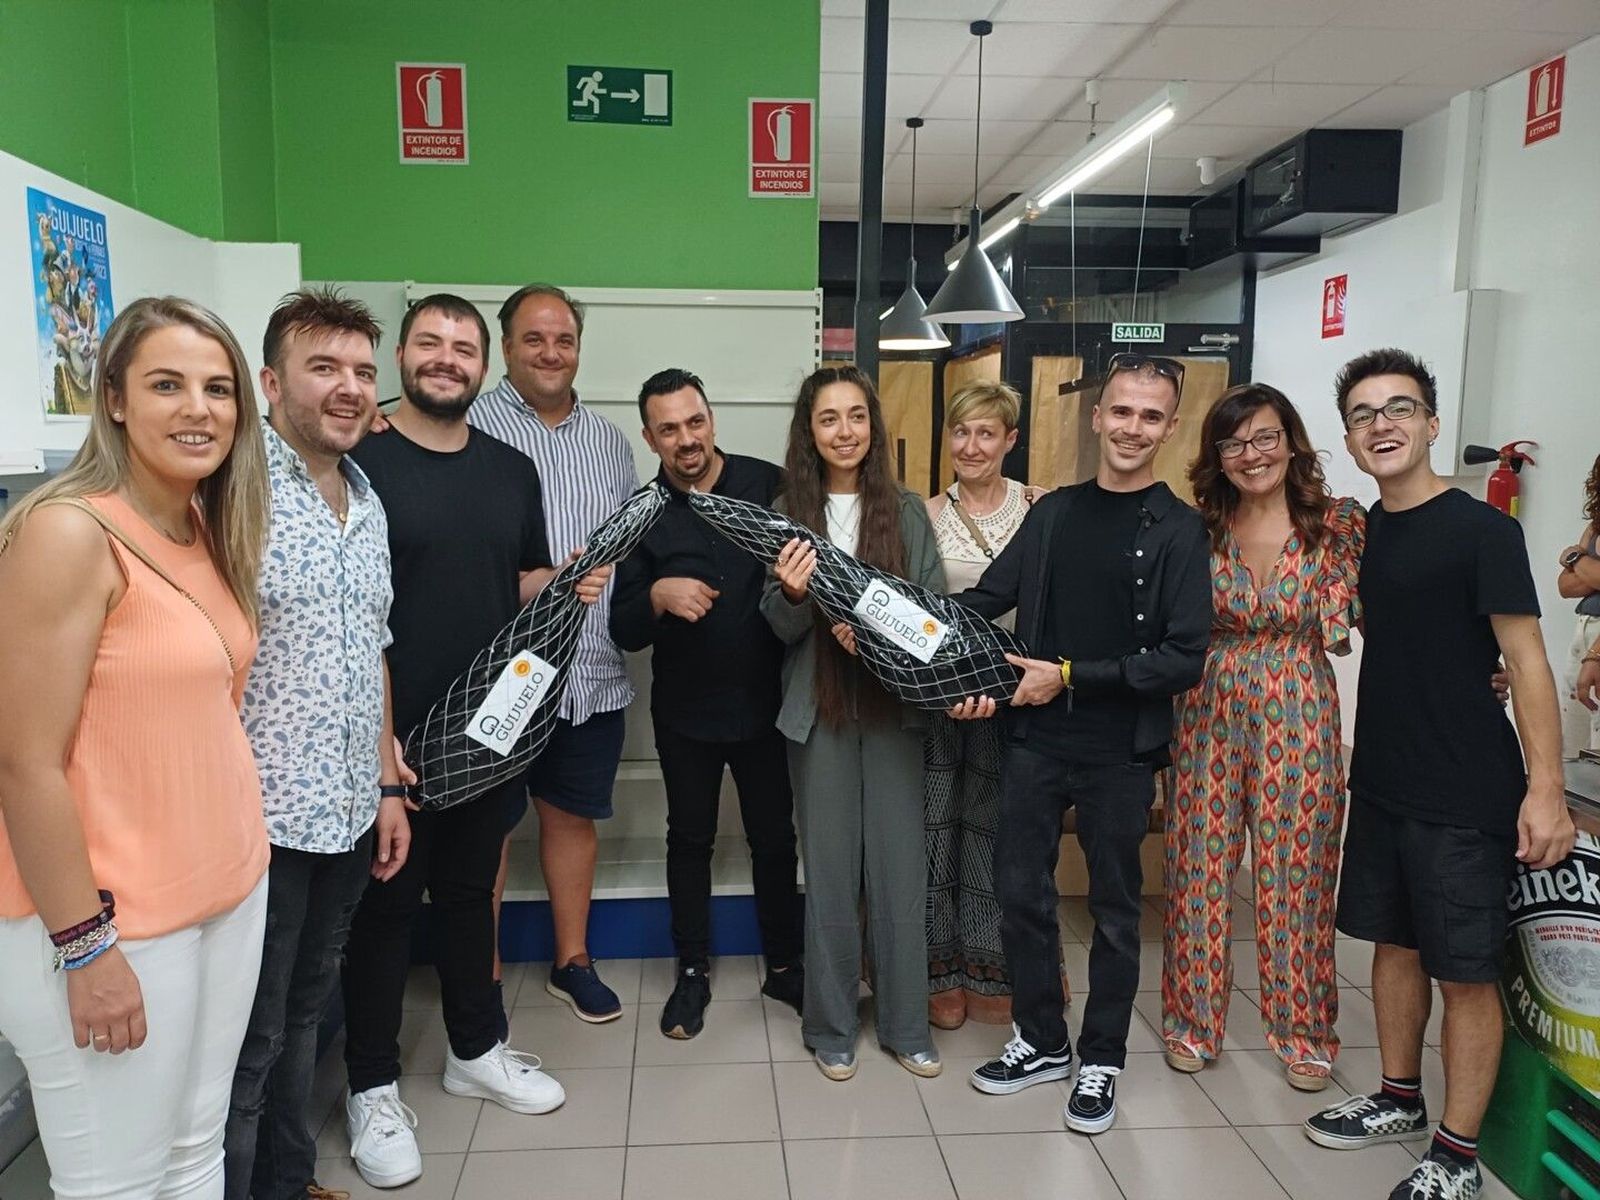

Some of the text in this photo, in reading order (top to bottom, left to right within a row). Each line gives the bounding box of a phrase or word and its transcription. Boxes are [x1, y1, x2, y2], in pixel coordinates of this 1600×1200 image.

[406, 134, 462, 145] EXTINTOR DE
[411, 146, 457, 156] INCENDIOS
[755, 169, 809, 179] EXTINTOR DE
[760, 180, 804, 190] INCENDIOS
[50, 205, 104, 246] GUIJUELO
[1116, 326, 1160, 339] SALIDA
[865, 603, 928, 648] GUIJUELO
[495, 672, 544, 741] GUIJUELO
[1510, 973, 1600, 1060] PREMIUM
